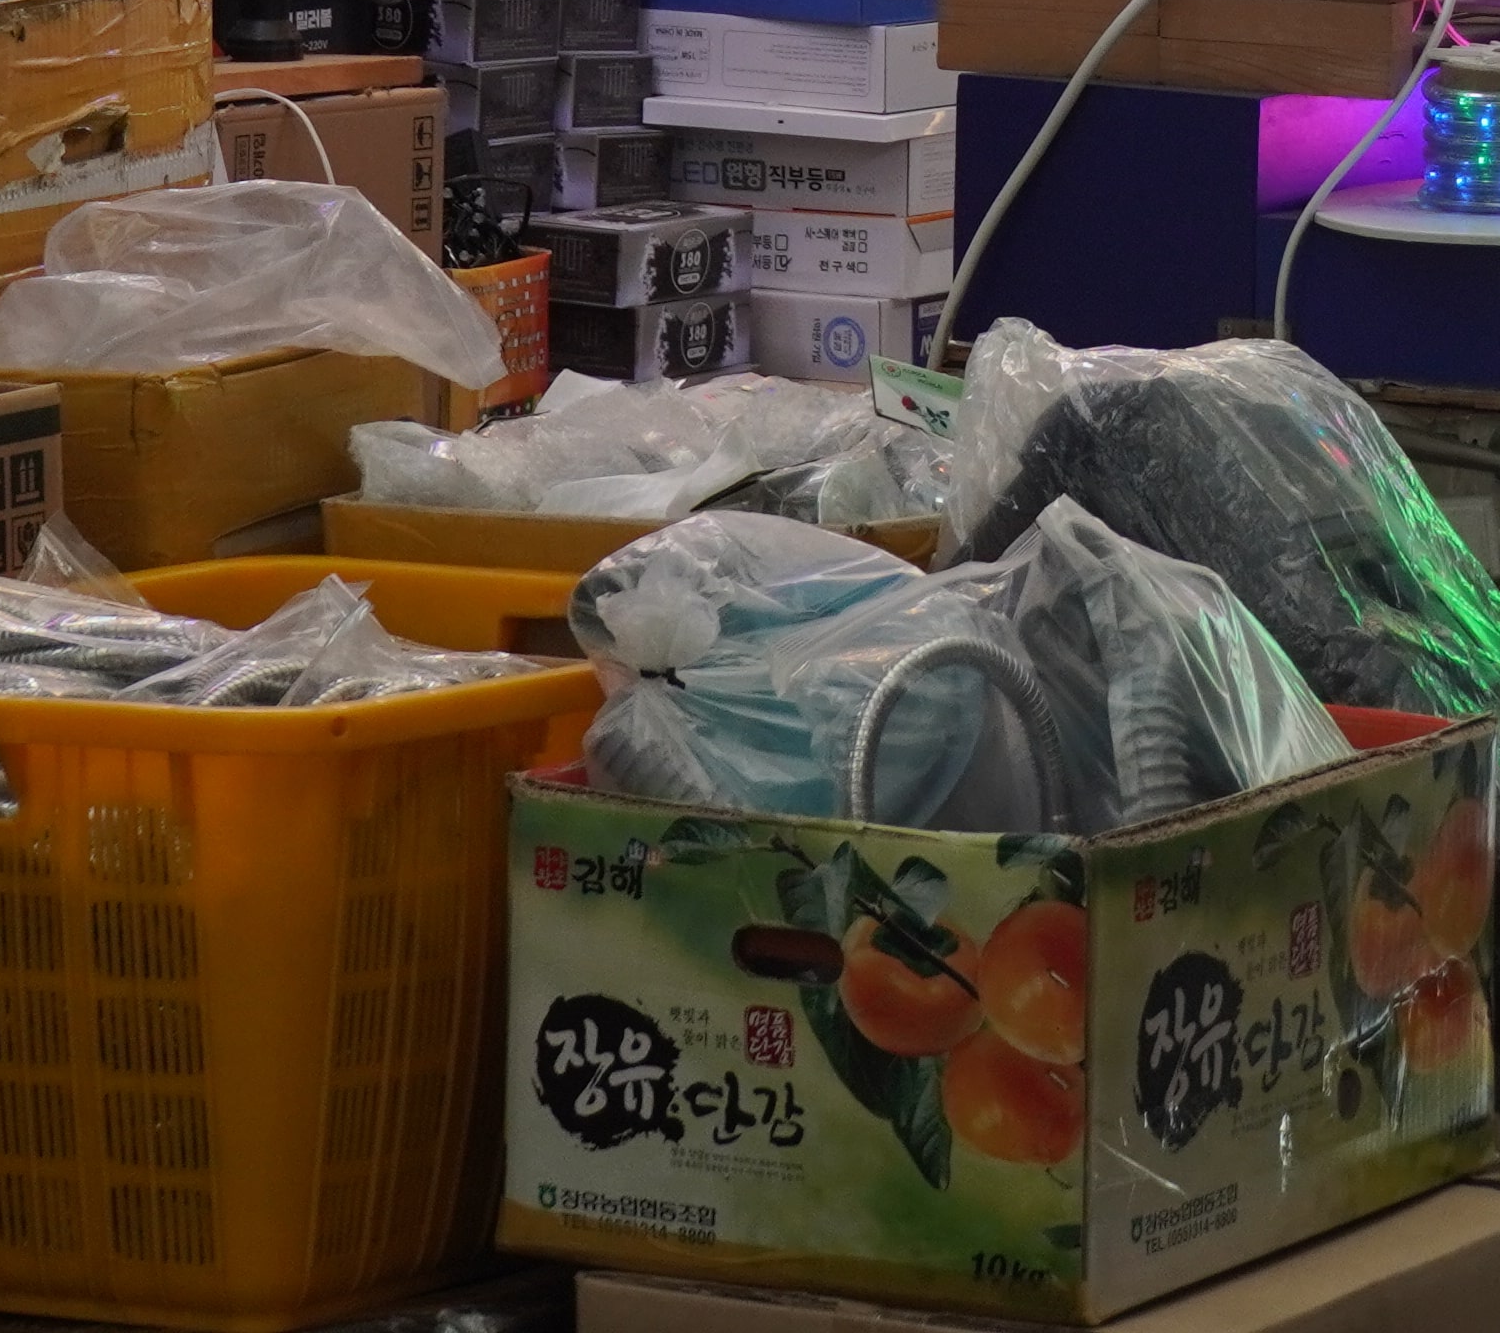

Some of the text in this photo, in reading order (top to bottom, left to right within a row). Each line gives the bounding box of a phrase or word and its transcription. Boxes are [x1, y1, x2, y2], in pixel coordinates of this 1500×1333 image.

[769, 165, 825, 192] 직부등
[572, 853, 646, 900] 김해
[1145, 983, 1326, 1105] 장유 단감
[544, 1018, 806, 1146] 장유 단감
[561, 1186, 717, 1228] 장유농업협동조합
